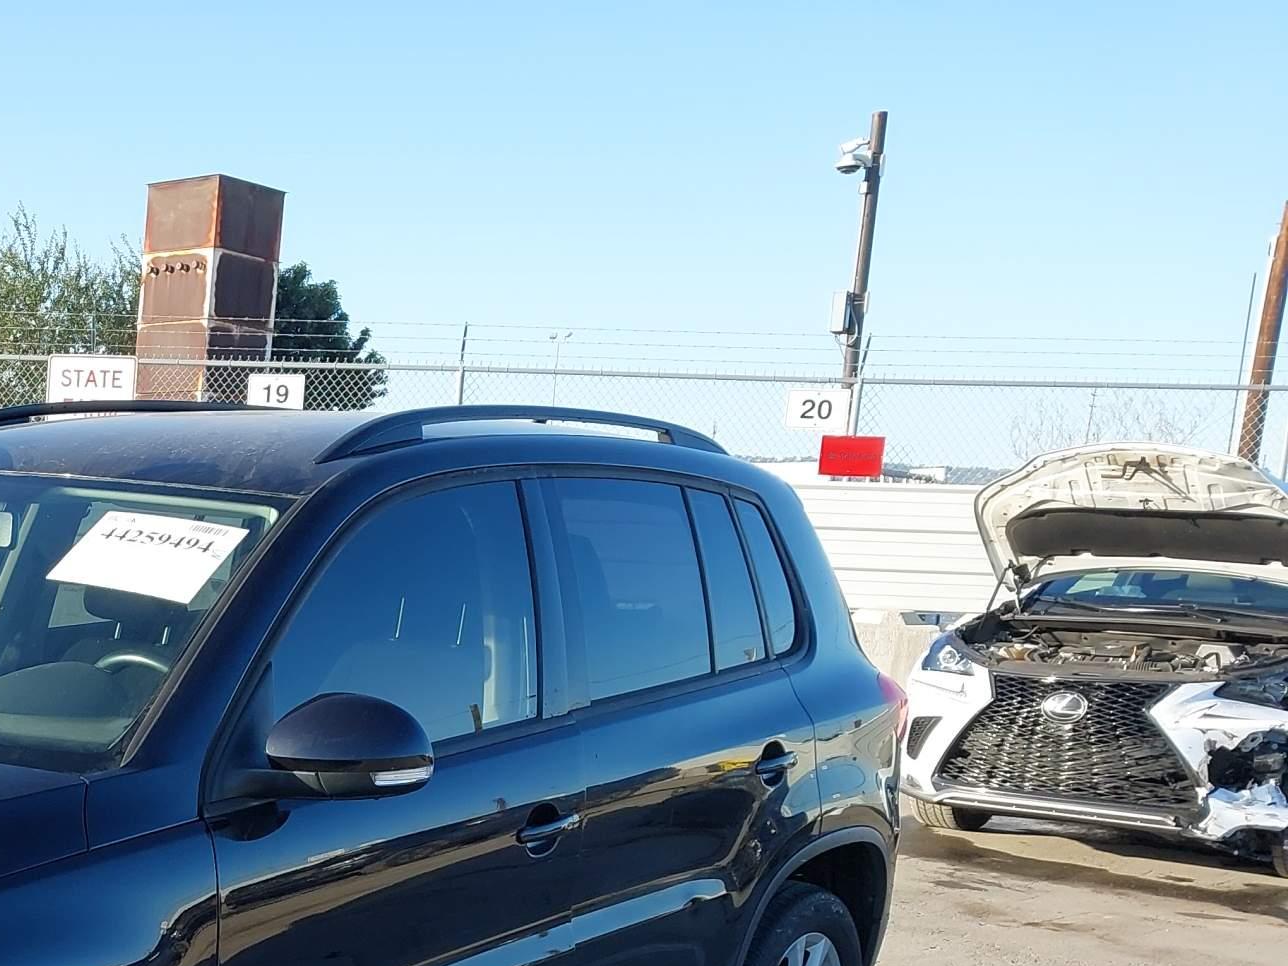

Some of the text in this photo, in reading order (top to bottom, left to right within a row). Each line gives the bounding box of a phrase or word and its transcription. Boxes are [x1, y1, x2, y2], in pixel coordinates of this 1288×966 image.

[60, 369, 123, 389] STATE
[263, 384, 289, 404] 19
[799, 399, 833, 420] 20
[100, 527, 215, 553] 44259494
